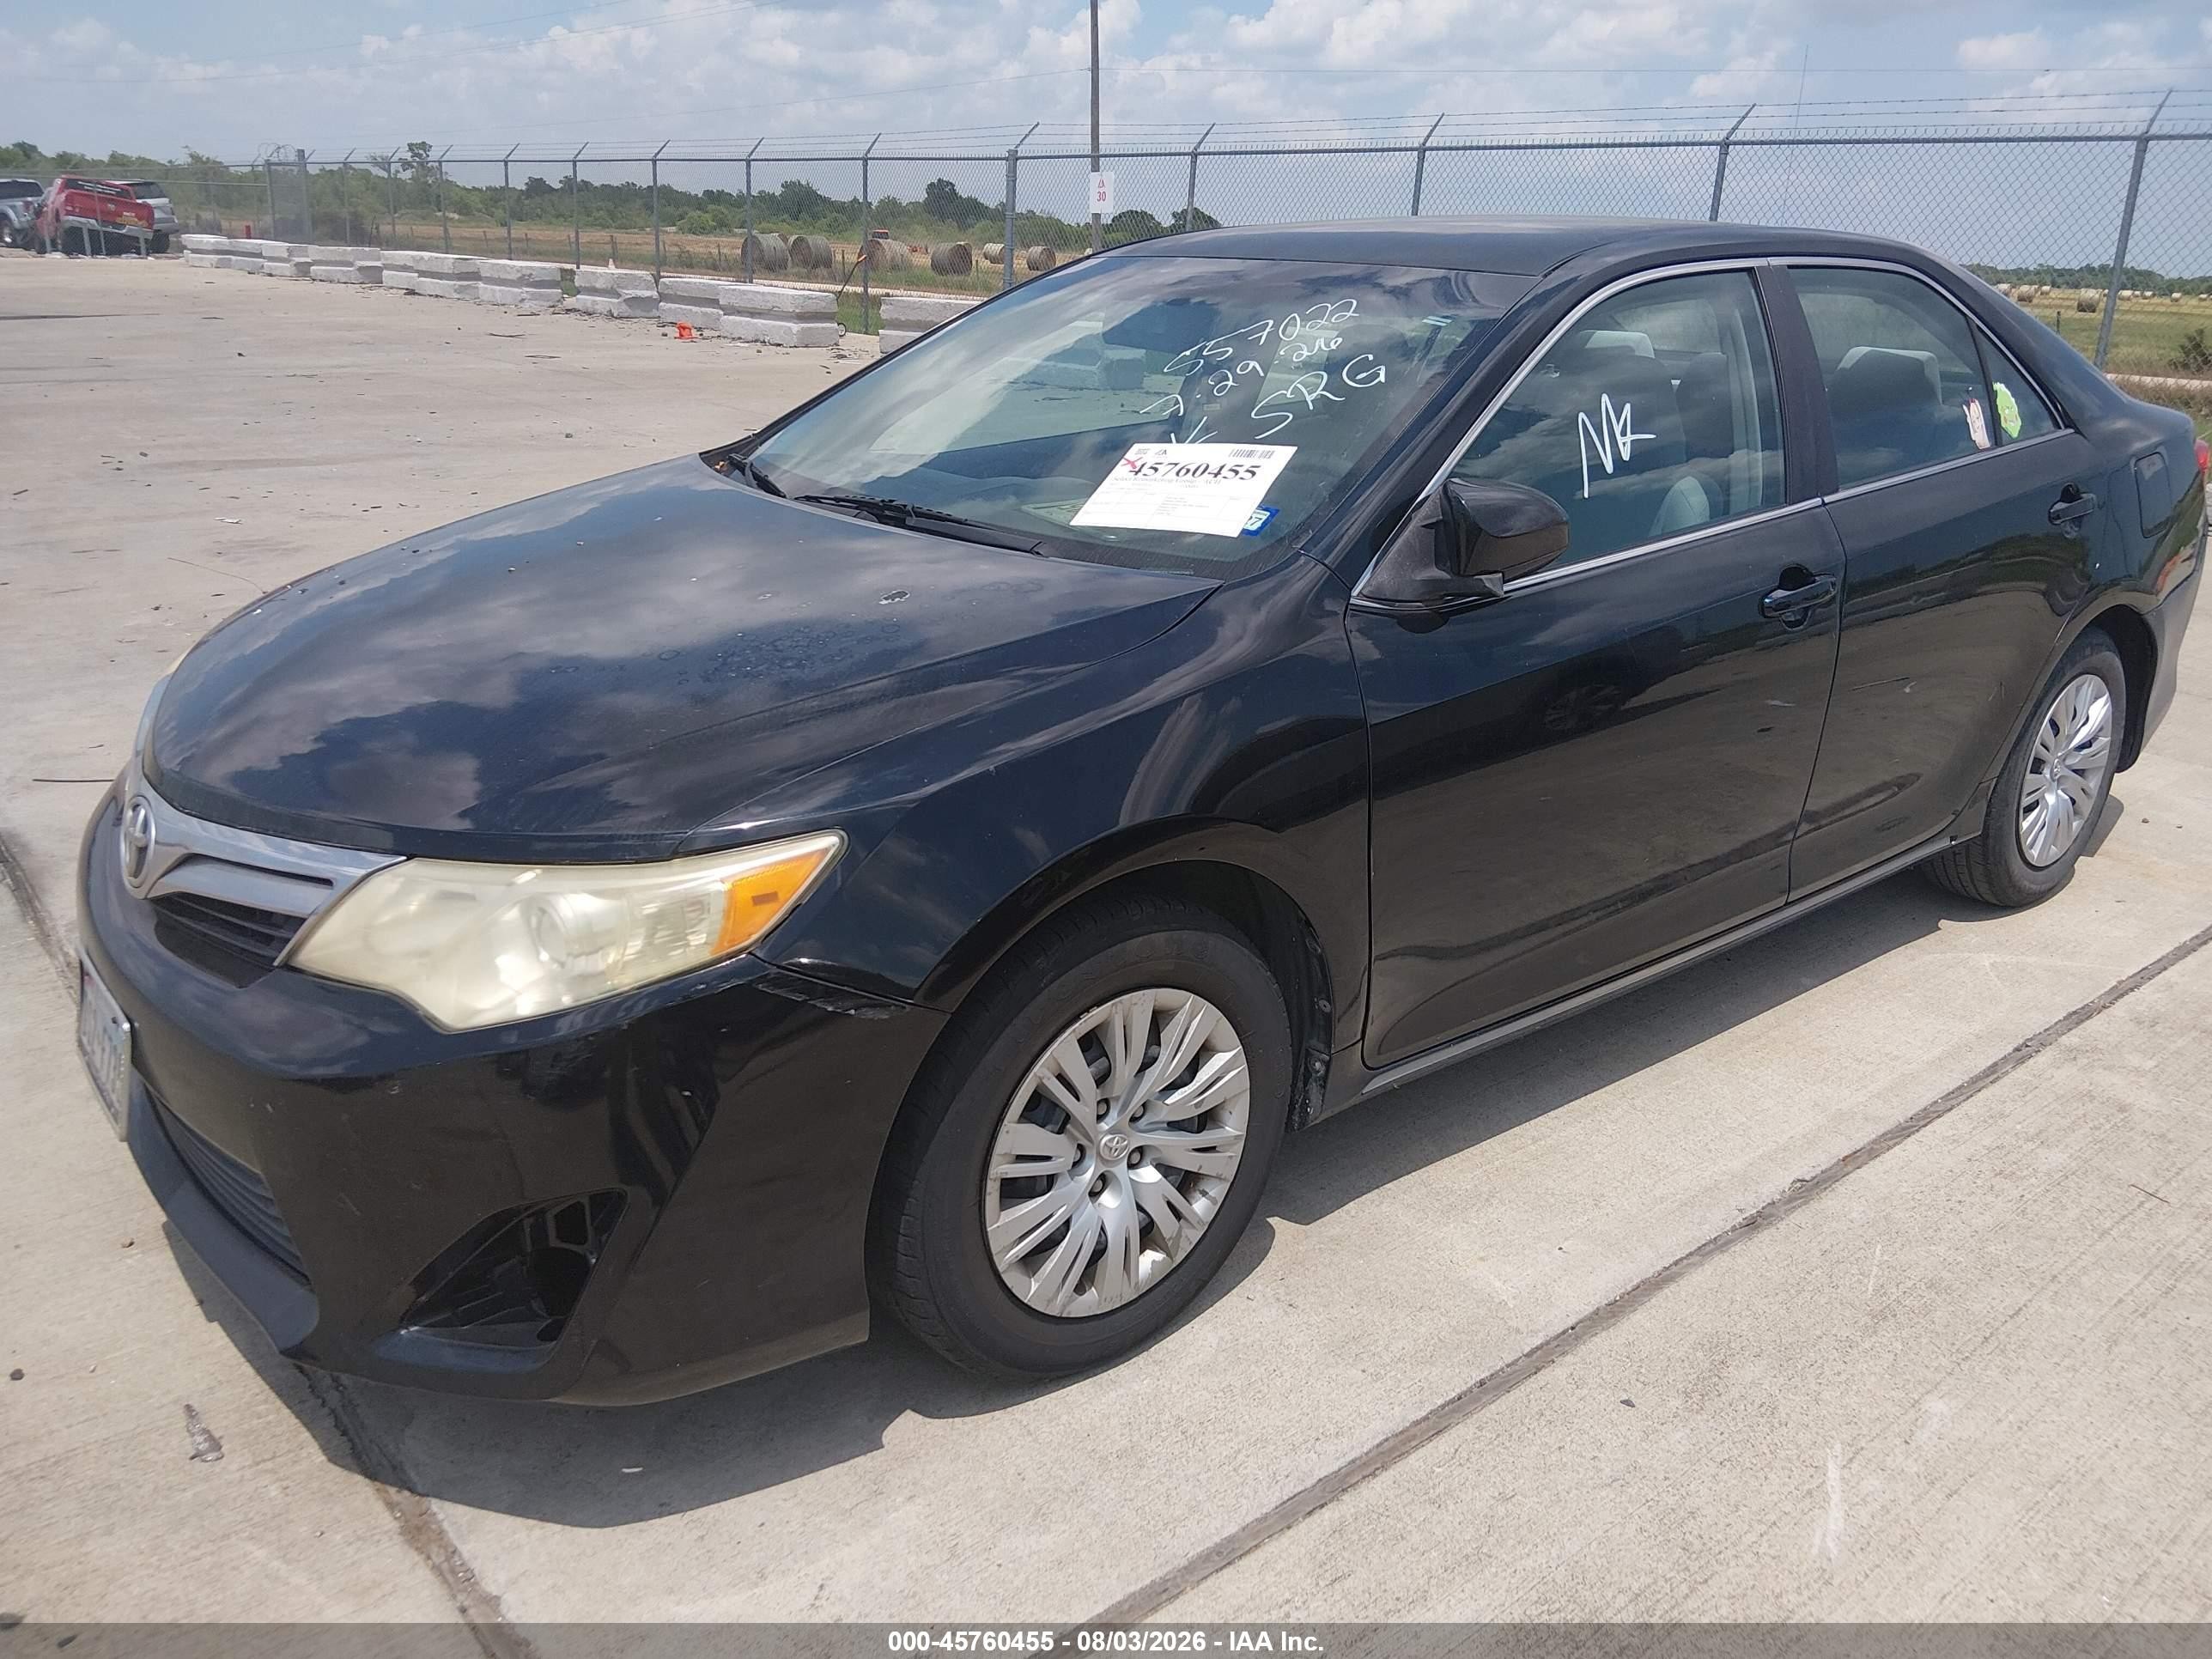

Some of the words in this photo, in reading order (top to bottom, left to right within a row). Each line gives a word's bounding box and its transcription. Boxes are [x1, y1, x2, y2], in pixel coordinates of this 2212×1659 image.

[1097, 191, 1107, 203] 30
[1163, 298, 1360, 376] 557022
[1250, 353, 1386, 440] SRG
[1127, 461, 1262, 481] 45760455
